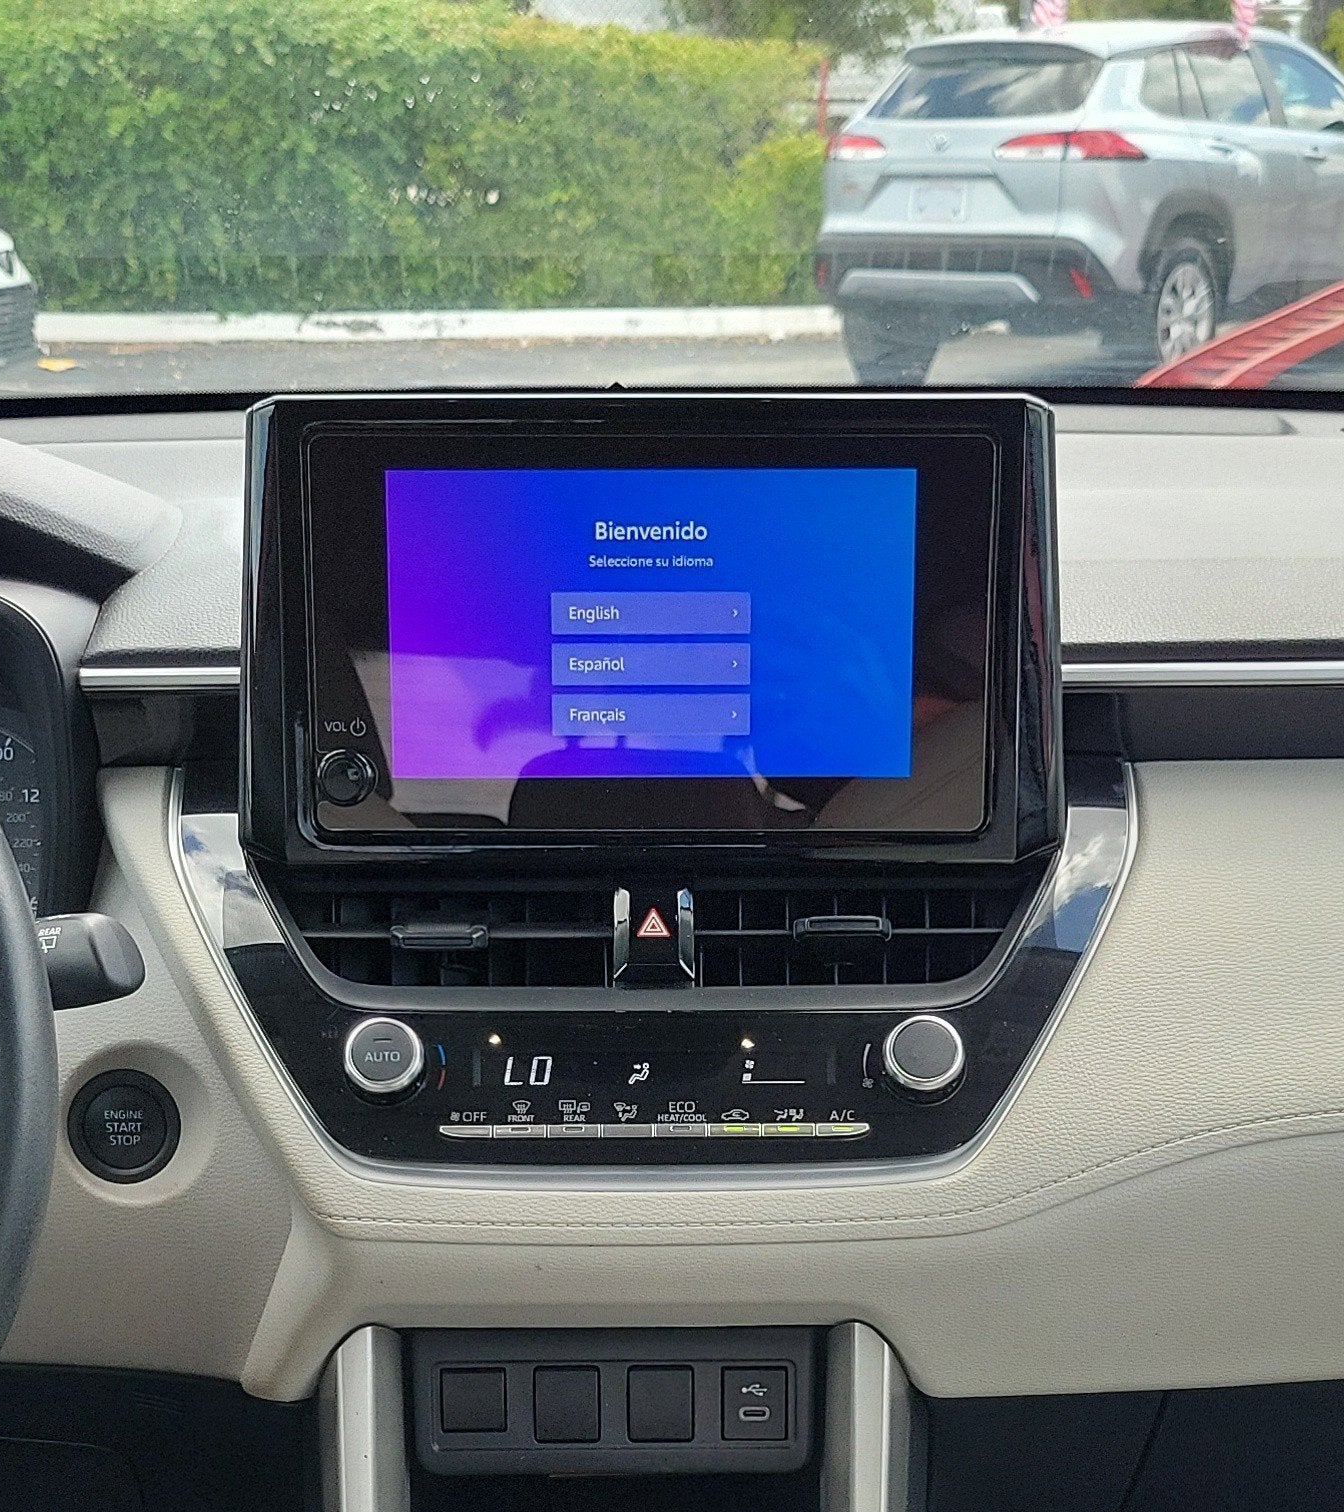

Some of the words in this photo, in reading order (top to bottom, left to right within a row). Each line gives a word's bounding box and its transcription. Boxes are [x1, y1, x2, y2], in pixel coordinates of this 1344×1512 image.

[595, 520, 708, 540] Bienvenido
[588, 554, 654, 568] Seleccione
[655, 557, 669, 567] su
[672, 555, 714, 567] idioma
[569, 605, 620, 624] English
[569, 657, 625, 673] Español
[570, 708, 626, 725] Français
[324, 721, 347, 732] VOL
[22, 789, 40, 802] 12
[38, 927, 61, 936] REAR
[364, 1051, 400, 1063] AUTO
[668, 1101, 696, 1113] ECO
[104, 1109, 144, 1120] ENGINE
[462, 1111, 487, 1122] OFF
[507, 1114, 535, 1122] FRONT
[563, 1114, 586, 1122] REAR
[657, 1113, 707, 1123] HEAT/COOL
[829, 1110, 855, 1121] A/C
[106, 1122, 142, 1133] START
[109, 1134, 141, 1146] STOP
